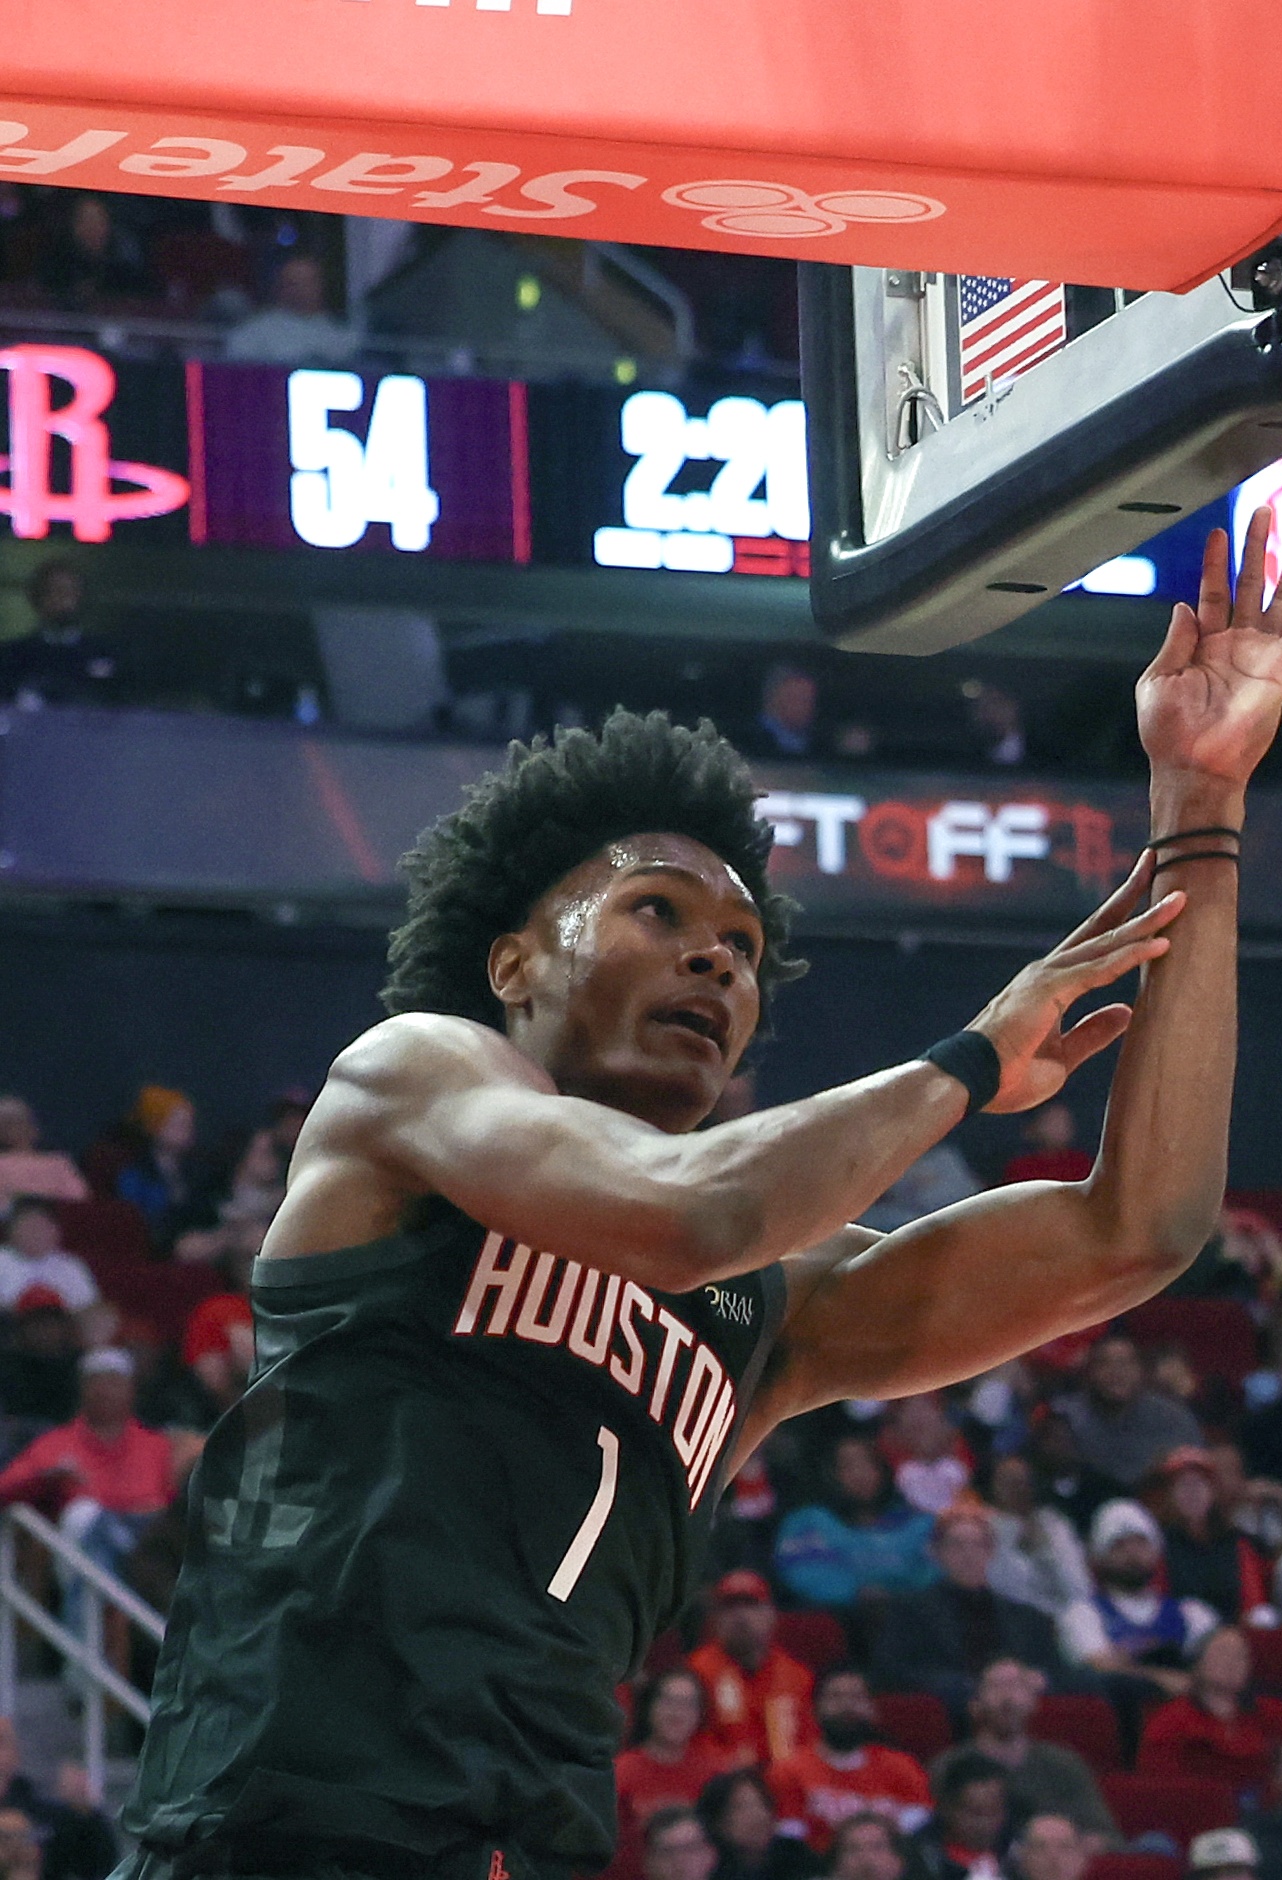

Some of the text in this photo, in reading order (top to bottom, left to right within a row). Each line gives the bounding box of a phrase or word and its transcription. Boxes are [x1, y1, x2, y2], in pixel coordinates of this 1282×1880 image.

[288, 368, 440, 552] 54
[452, 1229, 738, 1515] HOUSTON
[546, 1425, 620, 1603] 1
